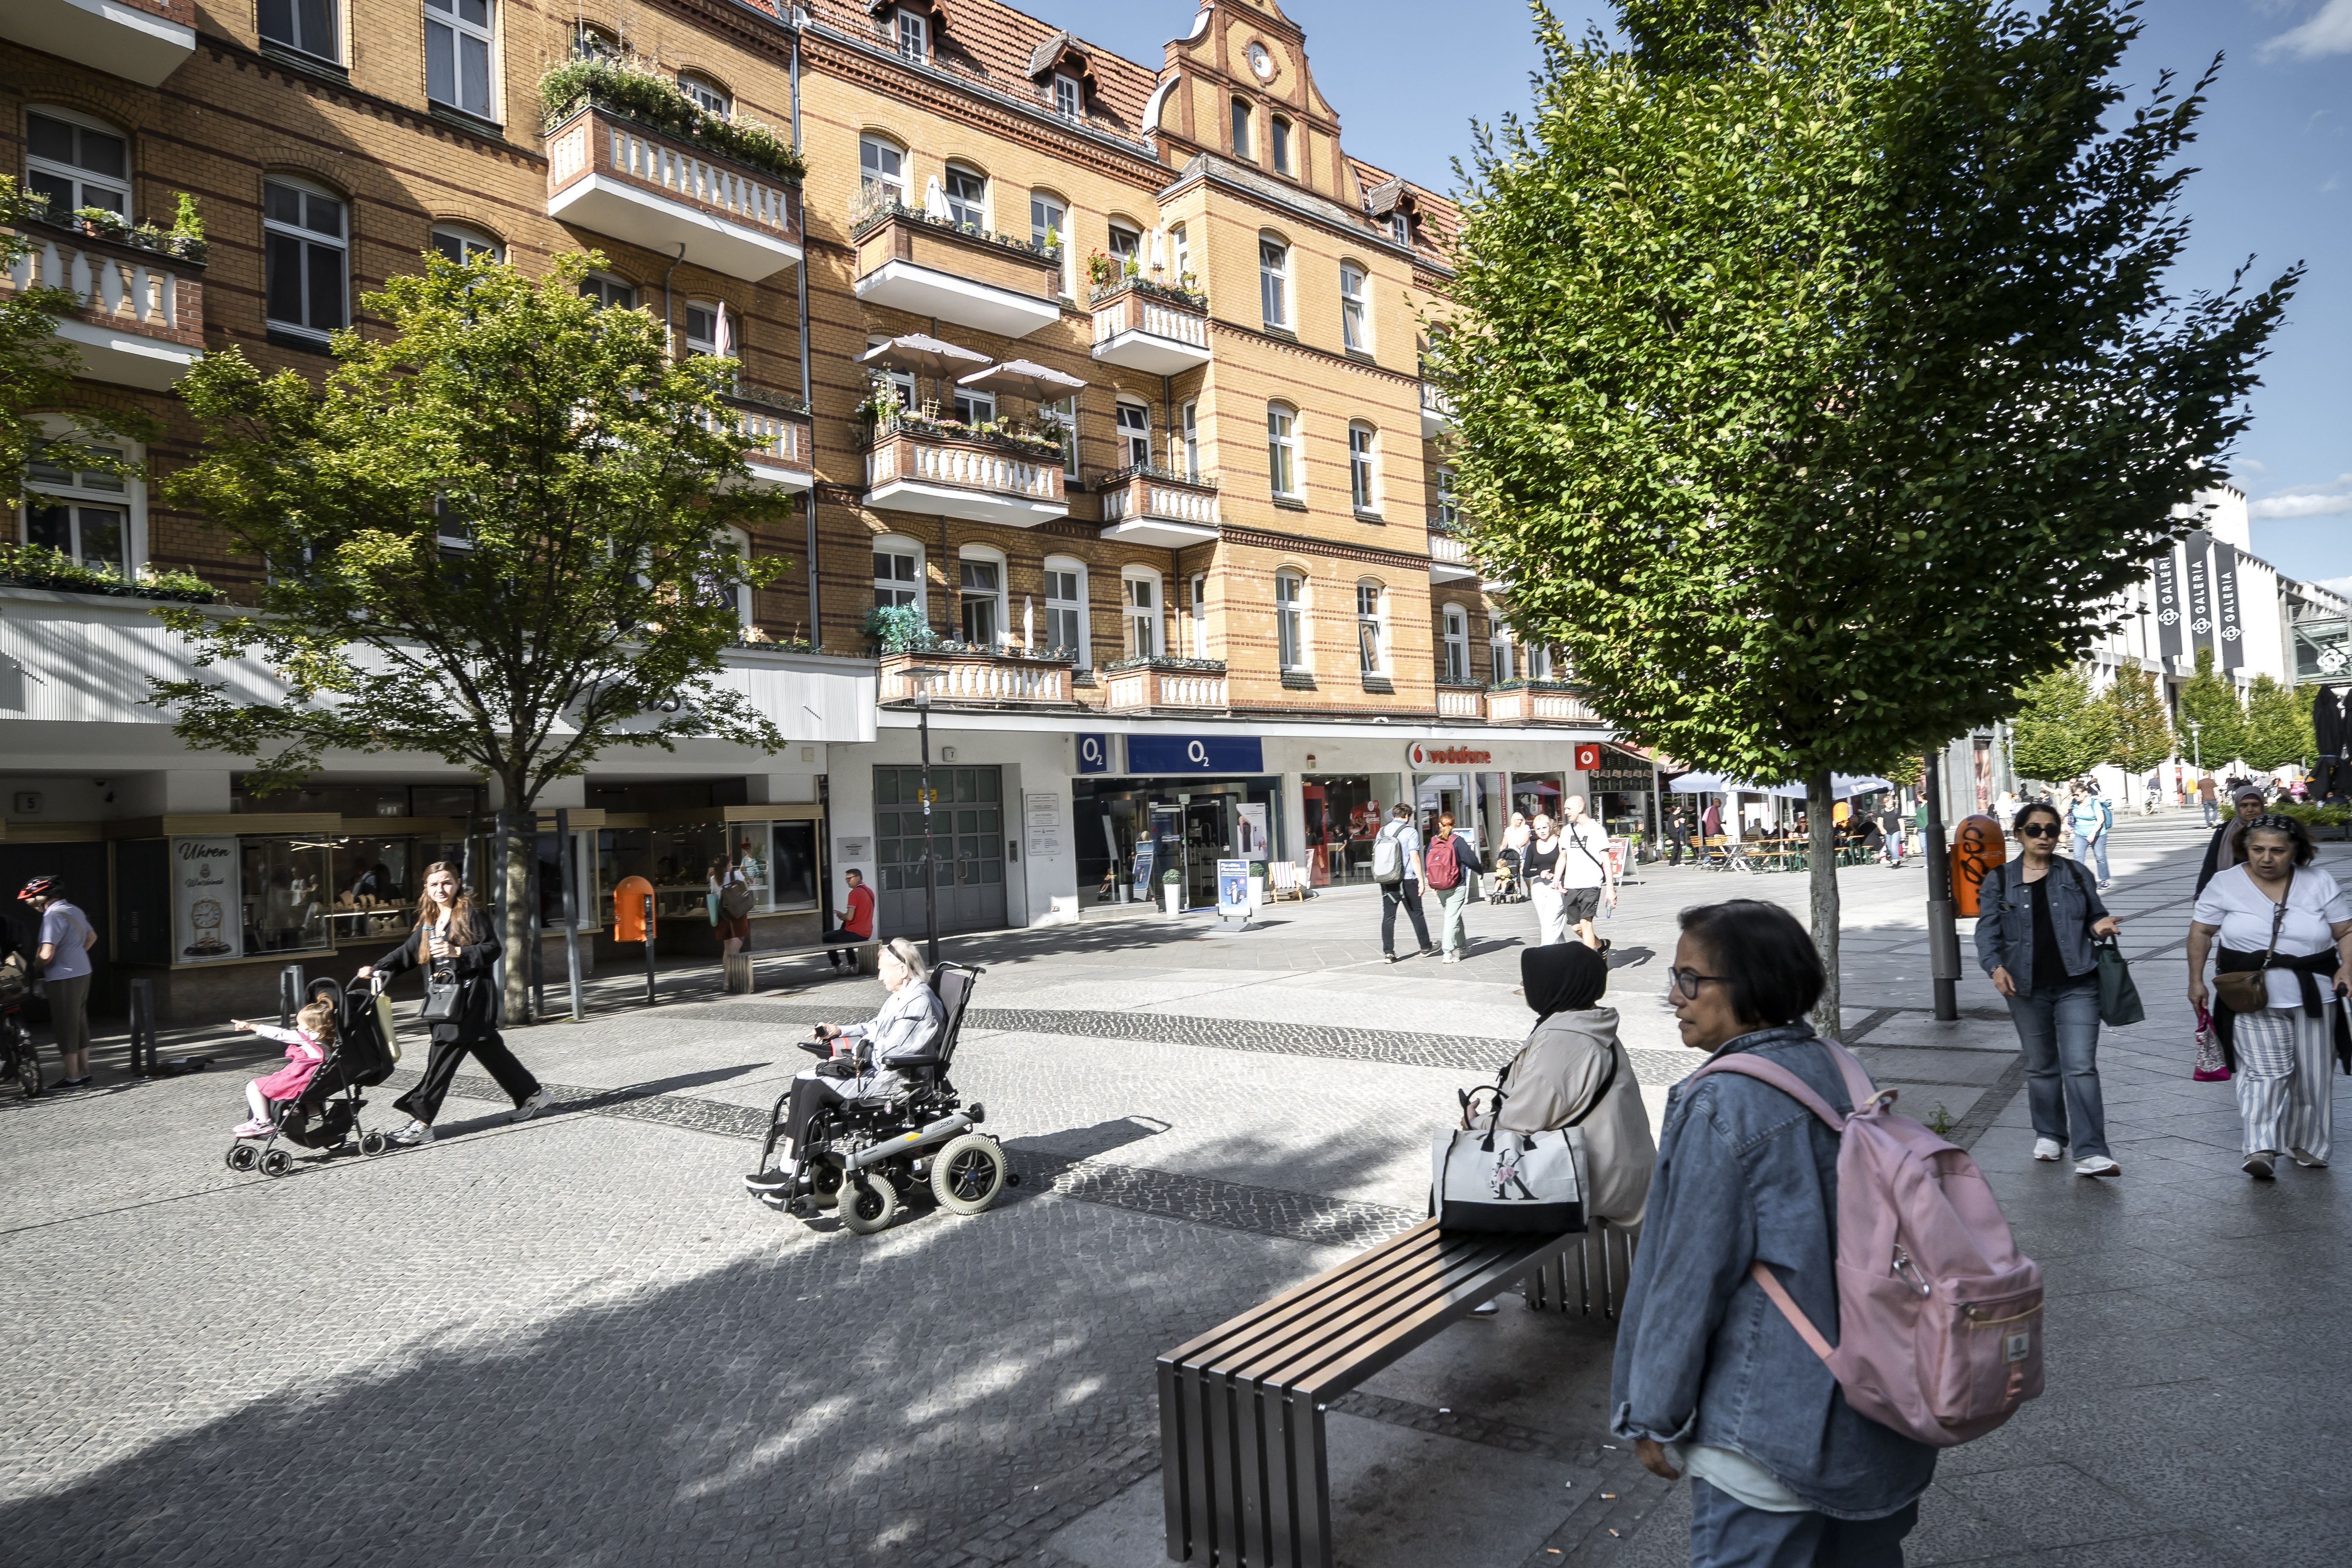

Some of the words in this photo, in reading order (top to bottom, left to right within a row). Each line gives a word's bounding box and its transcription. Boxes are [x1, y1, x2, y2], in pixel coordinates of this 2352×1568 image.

[2158, 557, 2173, 604] GALERI
[2191, 560, 2206, 614] GALERIA
[2221, 572, 2236, 622] GALERIA
[1429, 746, 1492, 764] vodafone
[27, 798, 35, 809] 5
[178, 842, 231, 860] Uhren
